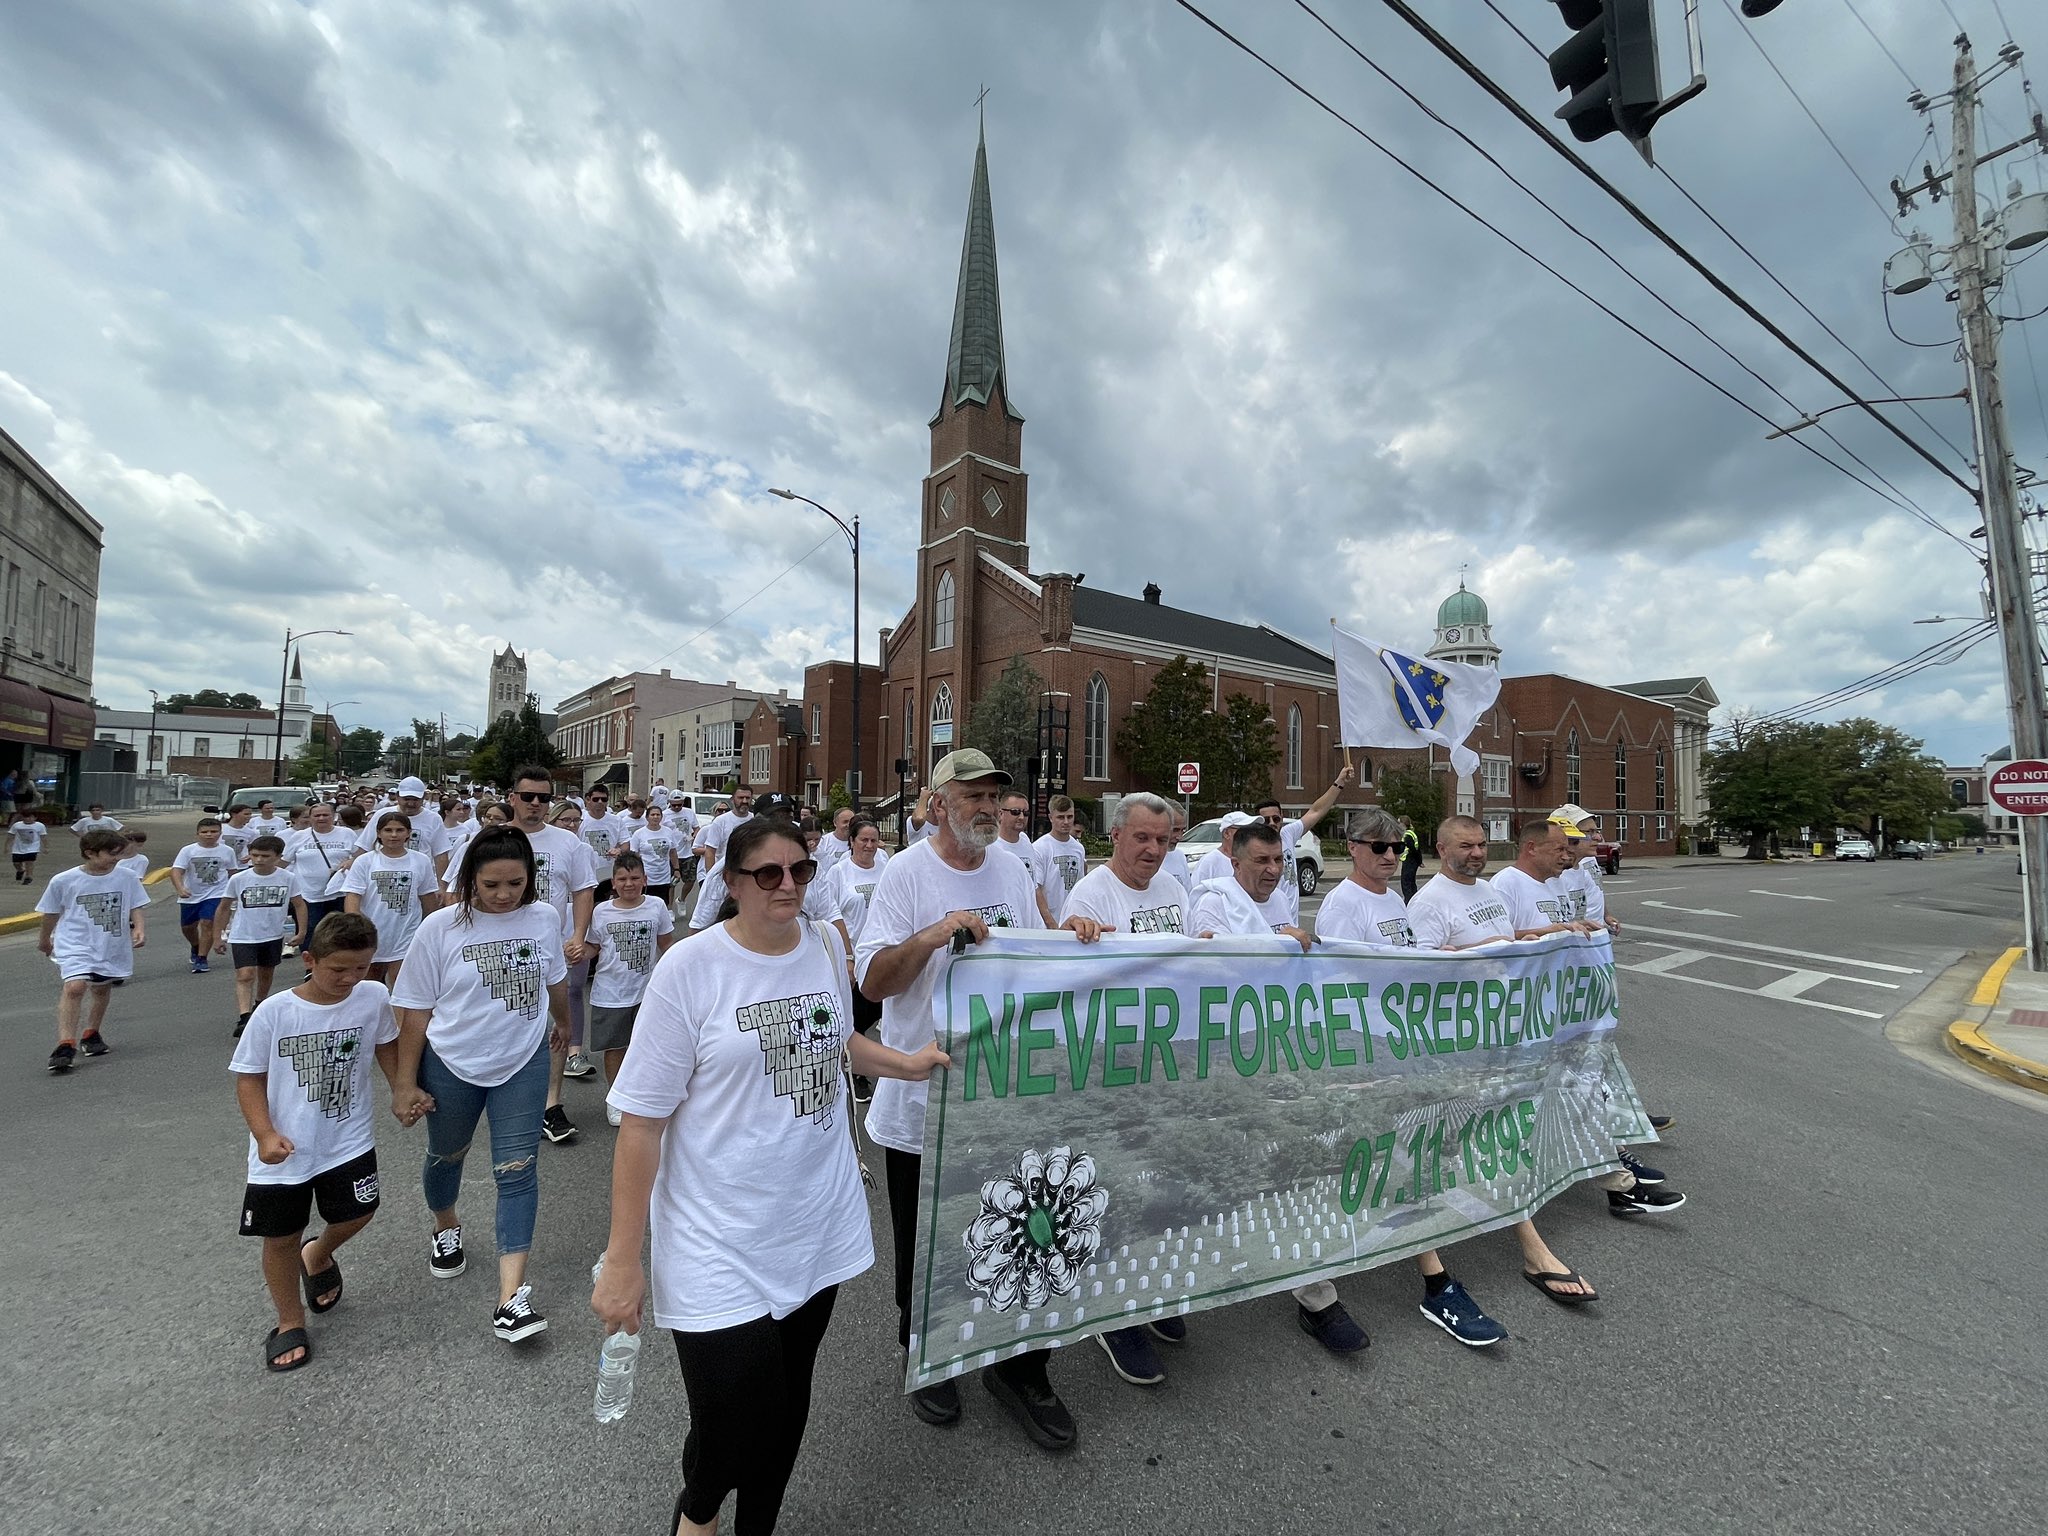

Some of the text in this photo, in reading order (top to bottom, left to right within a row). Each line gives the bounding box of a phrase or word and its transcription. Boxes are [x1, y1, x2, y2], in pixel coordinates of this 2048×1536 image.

[2000, 770, 2048, 781] DO NOT
[2006, 795, 2048, 805] ENTER
[491, 977, 540, 999] MOSTAR
[504, 991, 539, 1011] TUZLA
[964, 987, 1180, 1101] NEVER
[1197, 982, 1374, 1079] FORGET
[774, 1058, 838, 1097] MOSTAR
[791, 1080, 836, 1118] TUZLA
[1340, 1100, 1535, 1215] 07.11.1995
